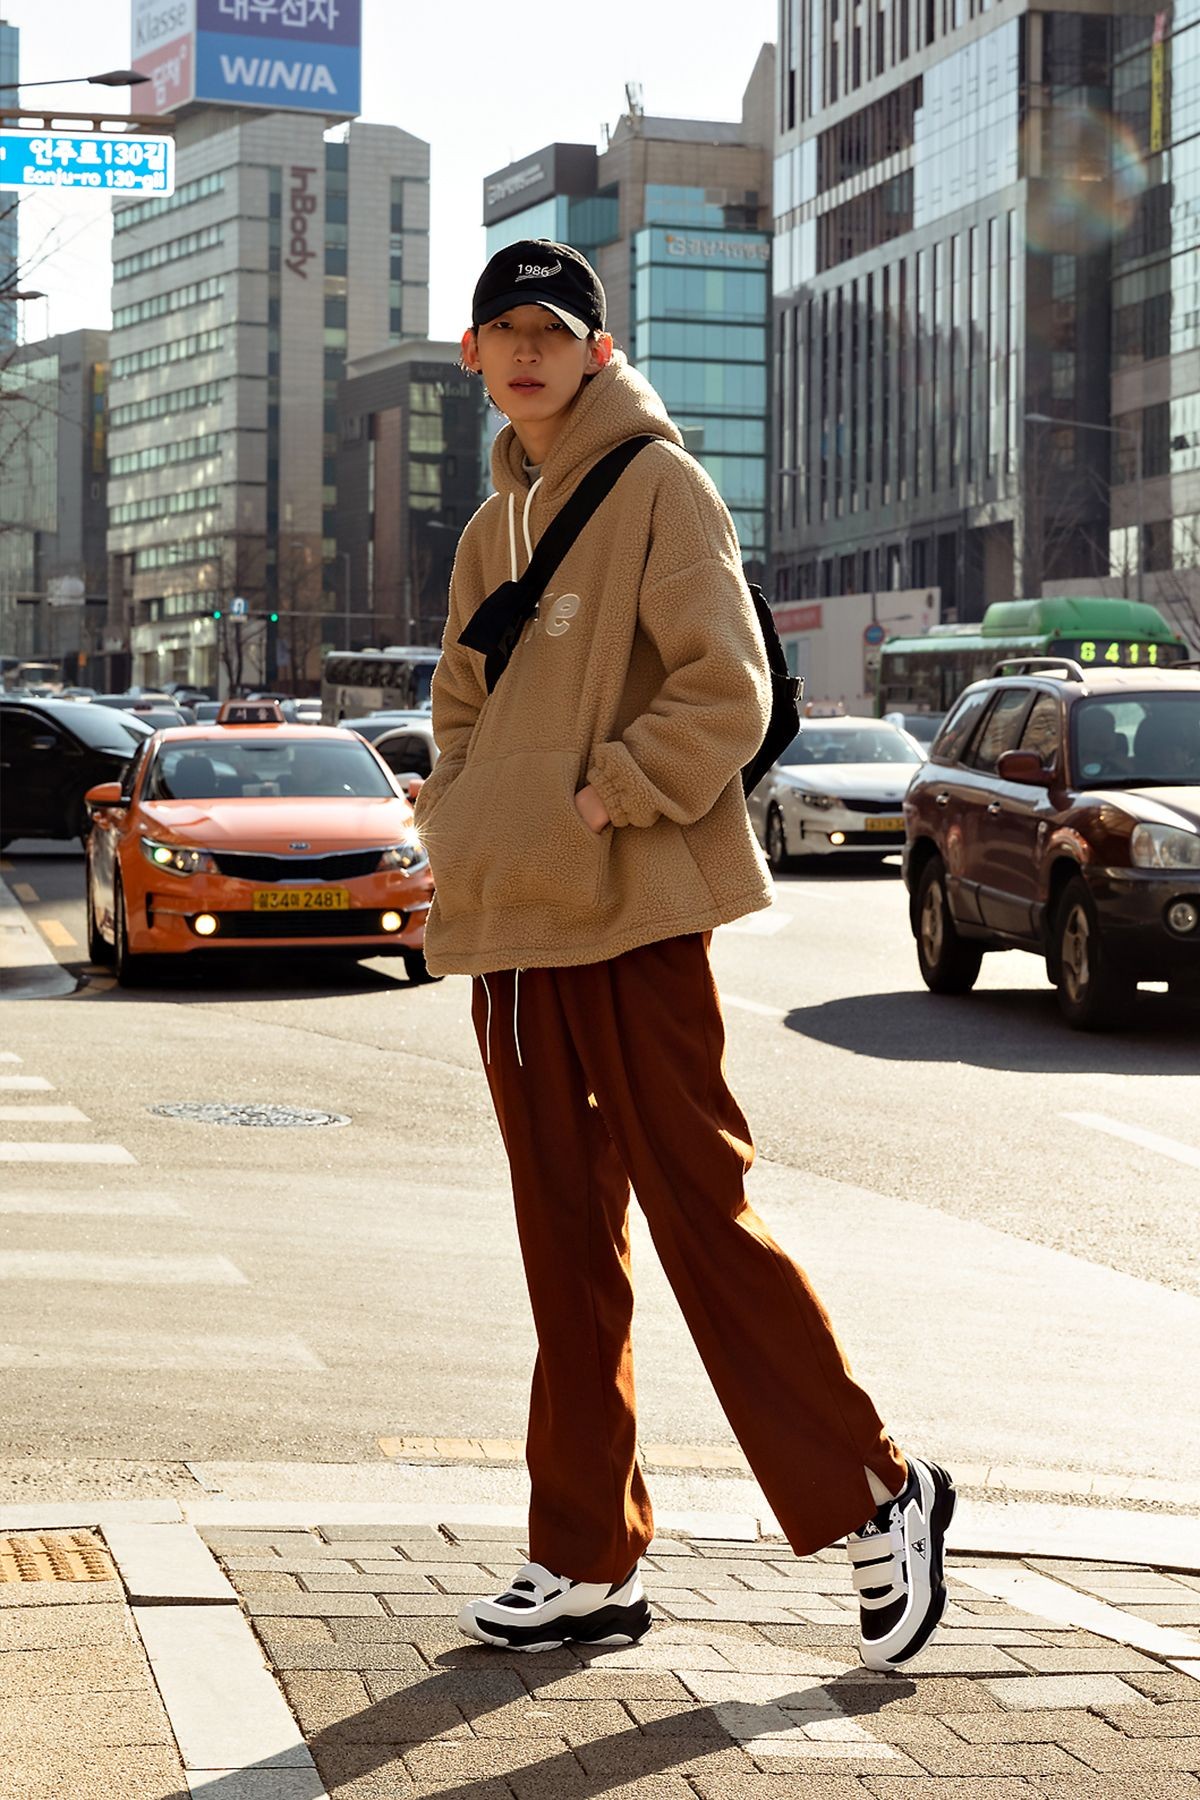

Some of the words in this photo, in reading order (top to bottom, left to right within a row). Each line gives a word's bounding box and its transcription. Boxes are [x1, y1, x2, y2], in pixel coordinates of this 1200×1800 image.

[218, 0, 340, 30] 대우전자
[219, 54, 337, 95] WINIA
[29, 138, 165, 170] 언주로130길
[23, 166, 101, 187] Eonju-ro
[105, 169, 165, 190] 130-gil
[285, 166, 317, 279] InBody
[517, 263, 549, 278] 1986
[304, 891, 343, 908] 2481
